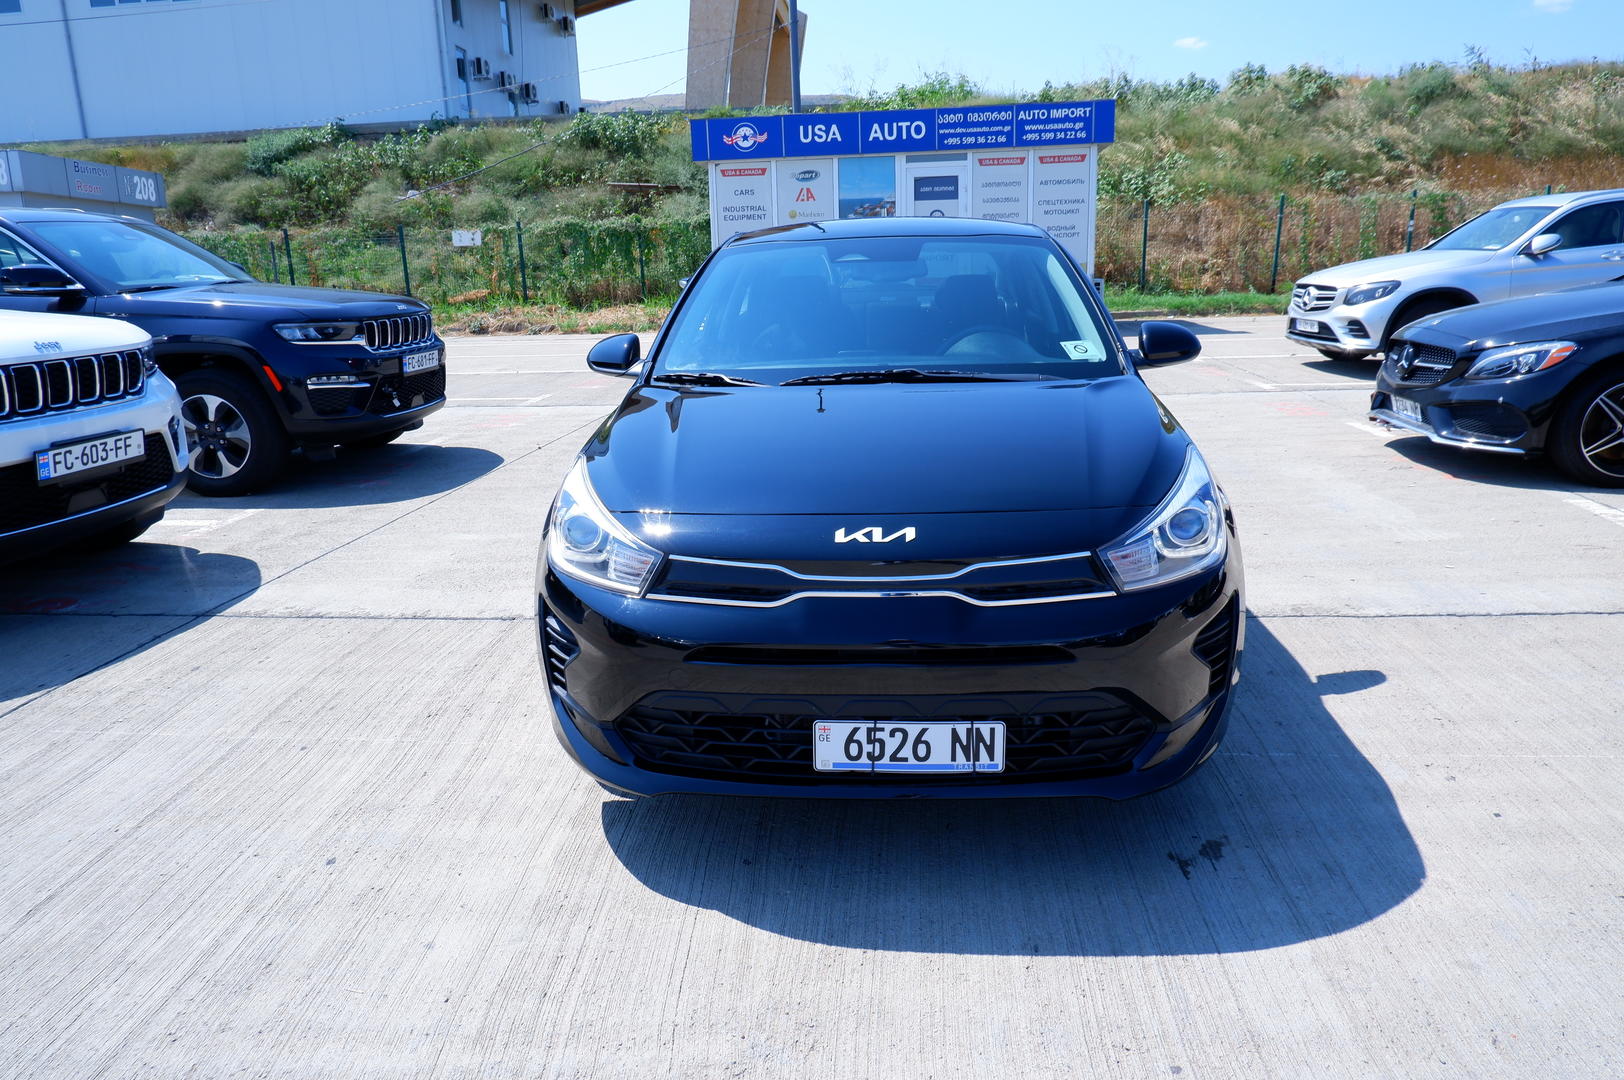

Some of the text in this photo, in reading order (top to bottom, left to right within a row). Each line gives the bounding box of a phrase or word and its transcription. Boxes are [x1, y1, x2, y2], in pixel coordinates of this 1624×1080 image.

[938, 111, 1012, 124] ავტო იმპორტი
[1018, 107, 1091, 120] AUTO IMPORT
[799, 120, 926, 143] USA AUTO
[1024, 122, 1084, 131] www.usaauto.ge
[944, 135, 1007, 145] +995 599 36 22 66
[1022, 130, 1087, 141] +995 599 34 22 66
[1039, 178, 1085, 186] АВТОМОБИЛЬ
[133, 176, 156, 202] 208
[734, 189, 755, 197] CARS
[1037, 198, 1086, 207] СПЕЦТЕХНИКА
[722, 205, 767, 213] INDUSTRIAL
[1043, 208, 1080, 216] МОТОЦИКЛ
[723, 213, 767, 222] EQUIPMENT
[52, 436, 132, 474] FC-603-FF
[834, 526, 916, 543] KIA
[818, 733, 831, 743] GE
[844, 727, 996, 762] 6526 NN
